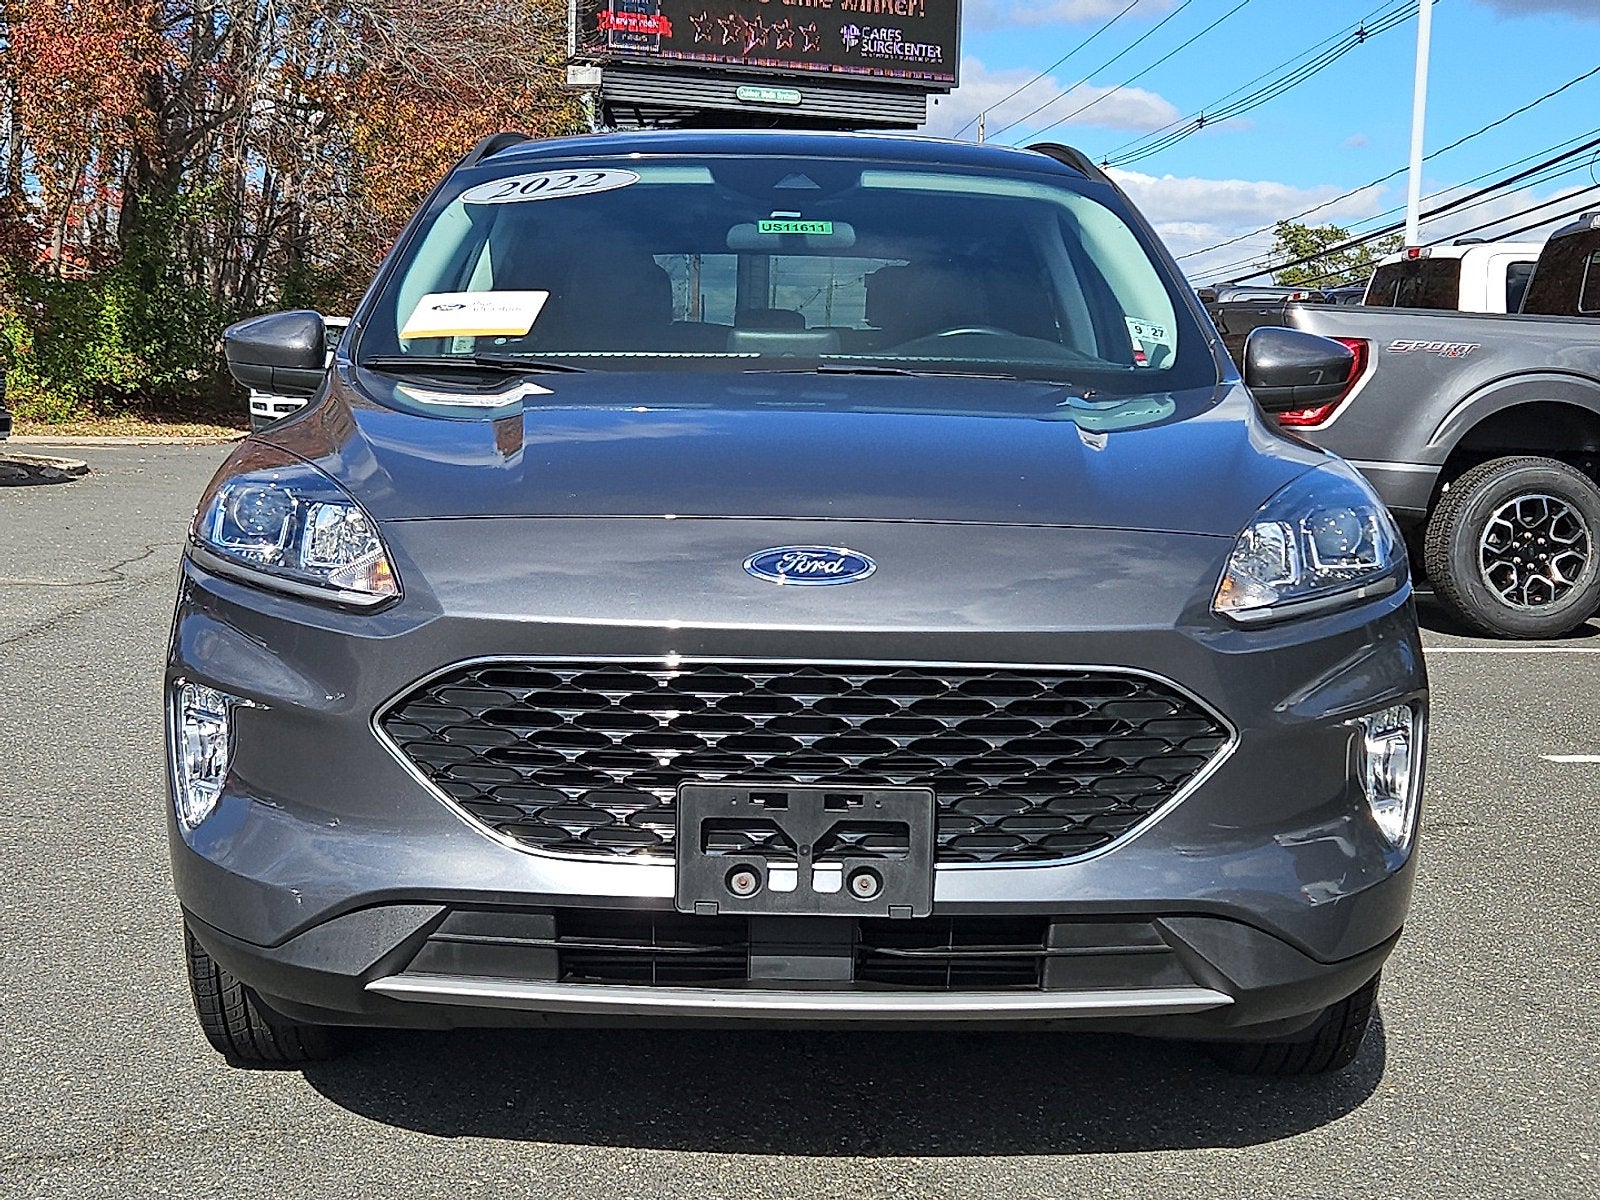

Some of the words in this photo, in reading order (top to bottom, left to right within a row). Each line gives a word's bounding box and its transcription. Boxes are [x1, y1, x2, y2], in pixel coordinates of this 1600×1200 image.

[861, 26, 902, 42] CARES
[860, 39, 943, 59] SURGICENTER
[487, 173, 606, 200] 2022
[761, 223, 825, 232] US11611
[1134, 325, 1143, 335] 9
[1150, 327, 1164, 338] 27
[1385, 339, 1481, 353] SPORT
[775, 551, 845, 574] Ford
